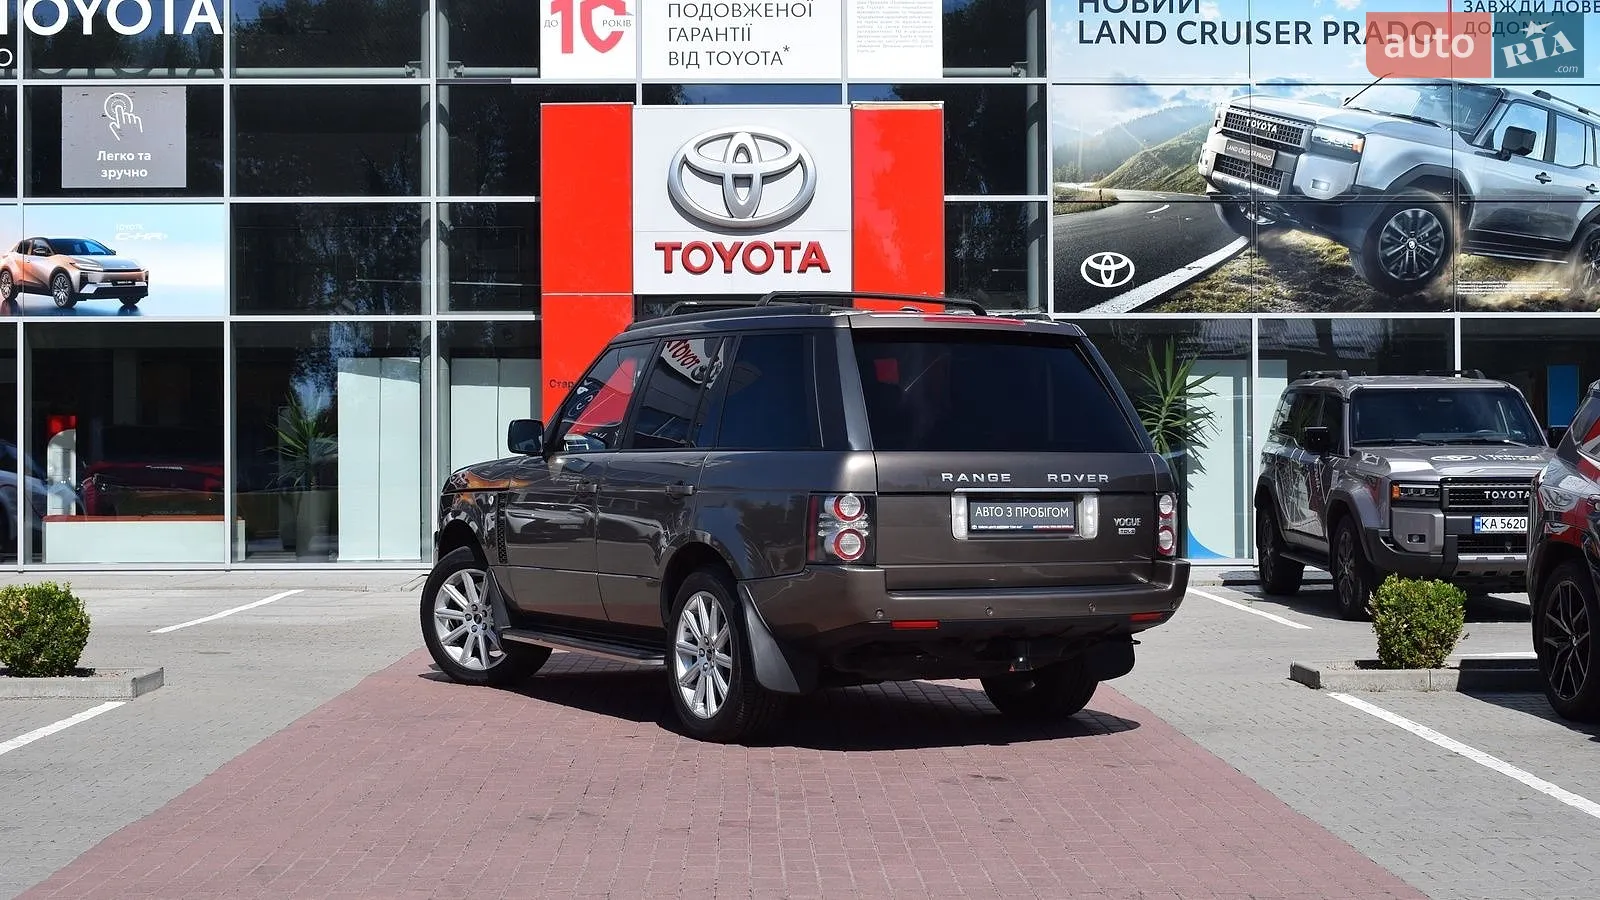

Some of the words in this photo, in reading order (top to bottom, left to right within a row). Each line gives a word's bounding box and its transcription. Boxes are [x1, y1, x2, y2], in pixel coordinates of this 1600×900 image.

[668, 0, 813, 20] ПОДОВЖЕНОЇ
[1463, 0, 1546, 16] ЗАВЖДИ
[0, 0, 224, 36] OYOTA
[602, 19, 632, 28] РОКІВ
[668, 23, 753, 43] ГАРАНТІЇ
[1078, 20, 1167, 45] LAND
[1176, 20, 1313, 46] CRUISER
[1322, 20, 1436, 46] PRADO
[668, 51, 700, 69] ВІД
[1245, 119, 1277, 133] TOYOTA
[96, 150, 135, 161] Легко
[137, 152, 152, 161] та
[100, 168, 149, 180] зручно
[655, 240, 831, 275] TOYOTA
[941, 473, 1012, 483] RANGE
[1047, 473, 1110, 484] ROVER
[1484, 490, 1530, 499] TOYOTA
[975, 506, 1004, 517] АВТО
[1015, 507, 1069, 518] ПРОБІГОМ
[1113, 517, 1142, 526] VOGUE
[1481, 518, 1498, 530] KA
[1500, 518, 1526, 530] 5620
